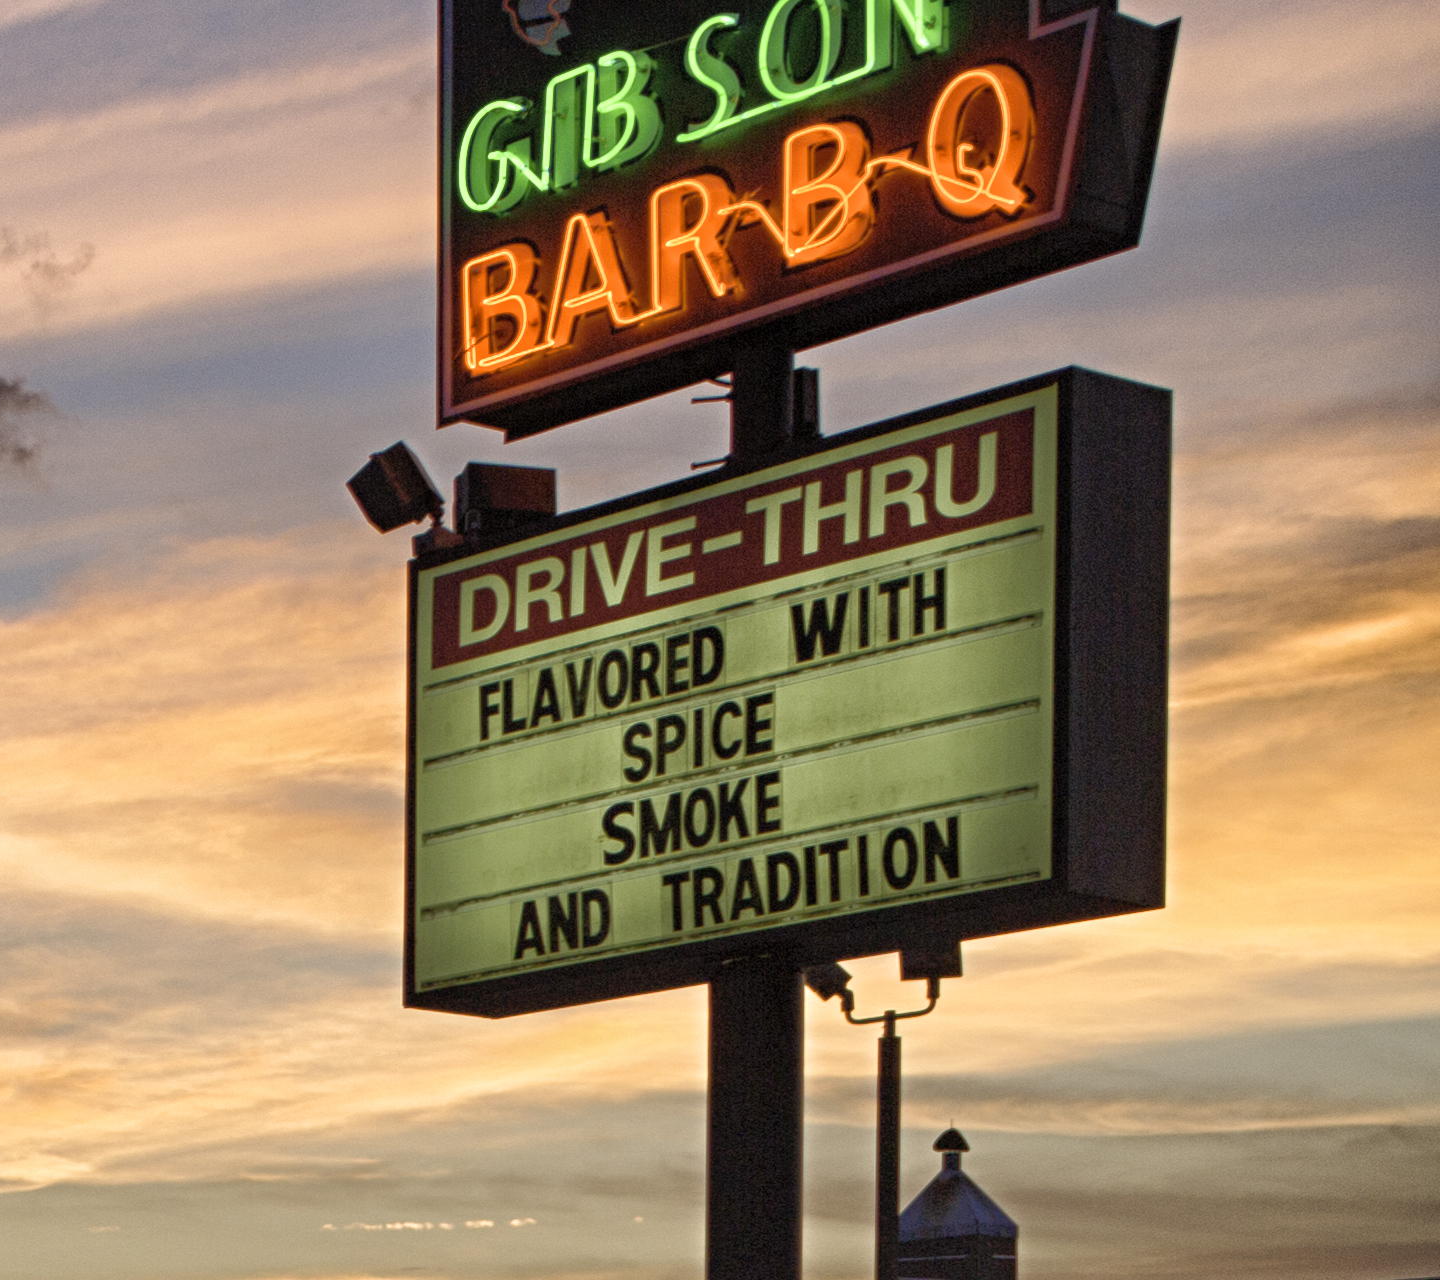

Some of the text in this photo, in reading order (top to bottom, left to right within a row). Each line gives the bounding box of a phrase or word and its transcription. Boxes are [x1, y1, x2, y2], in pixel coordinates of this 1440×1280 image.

[460, 63, 1037, 375] BAR-B-Q
[457, 430, 1001, 649] DRIVE-THRU
[480, 566, 948, 742] FLAVORED WITH
[622, 691, 775, 784] SPICE
[512, 816, 961, 961] AND TRADITION
[601, 771, 782, 868] SMOKE
